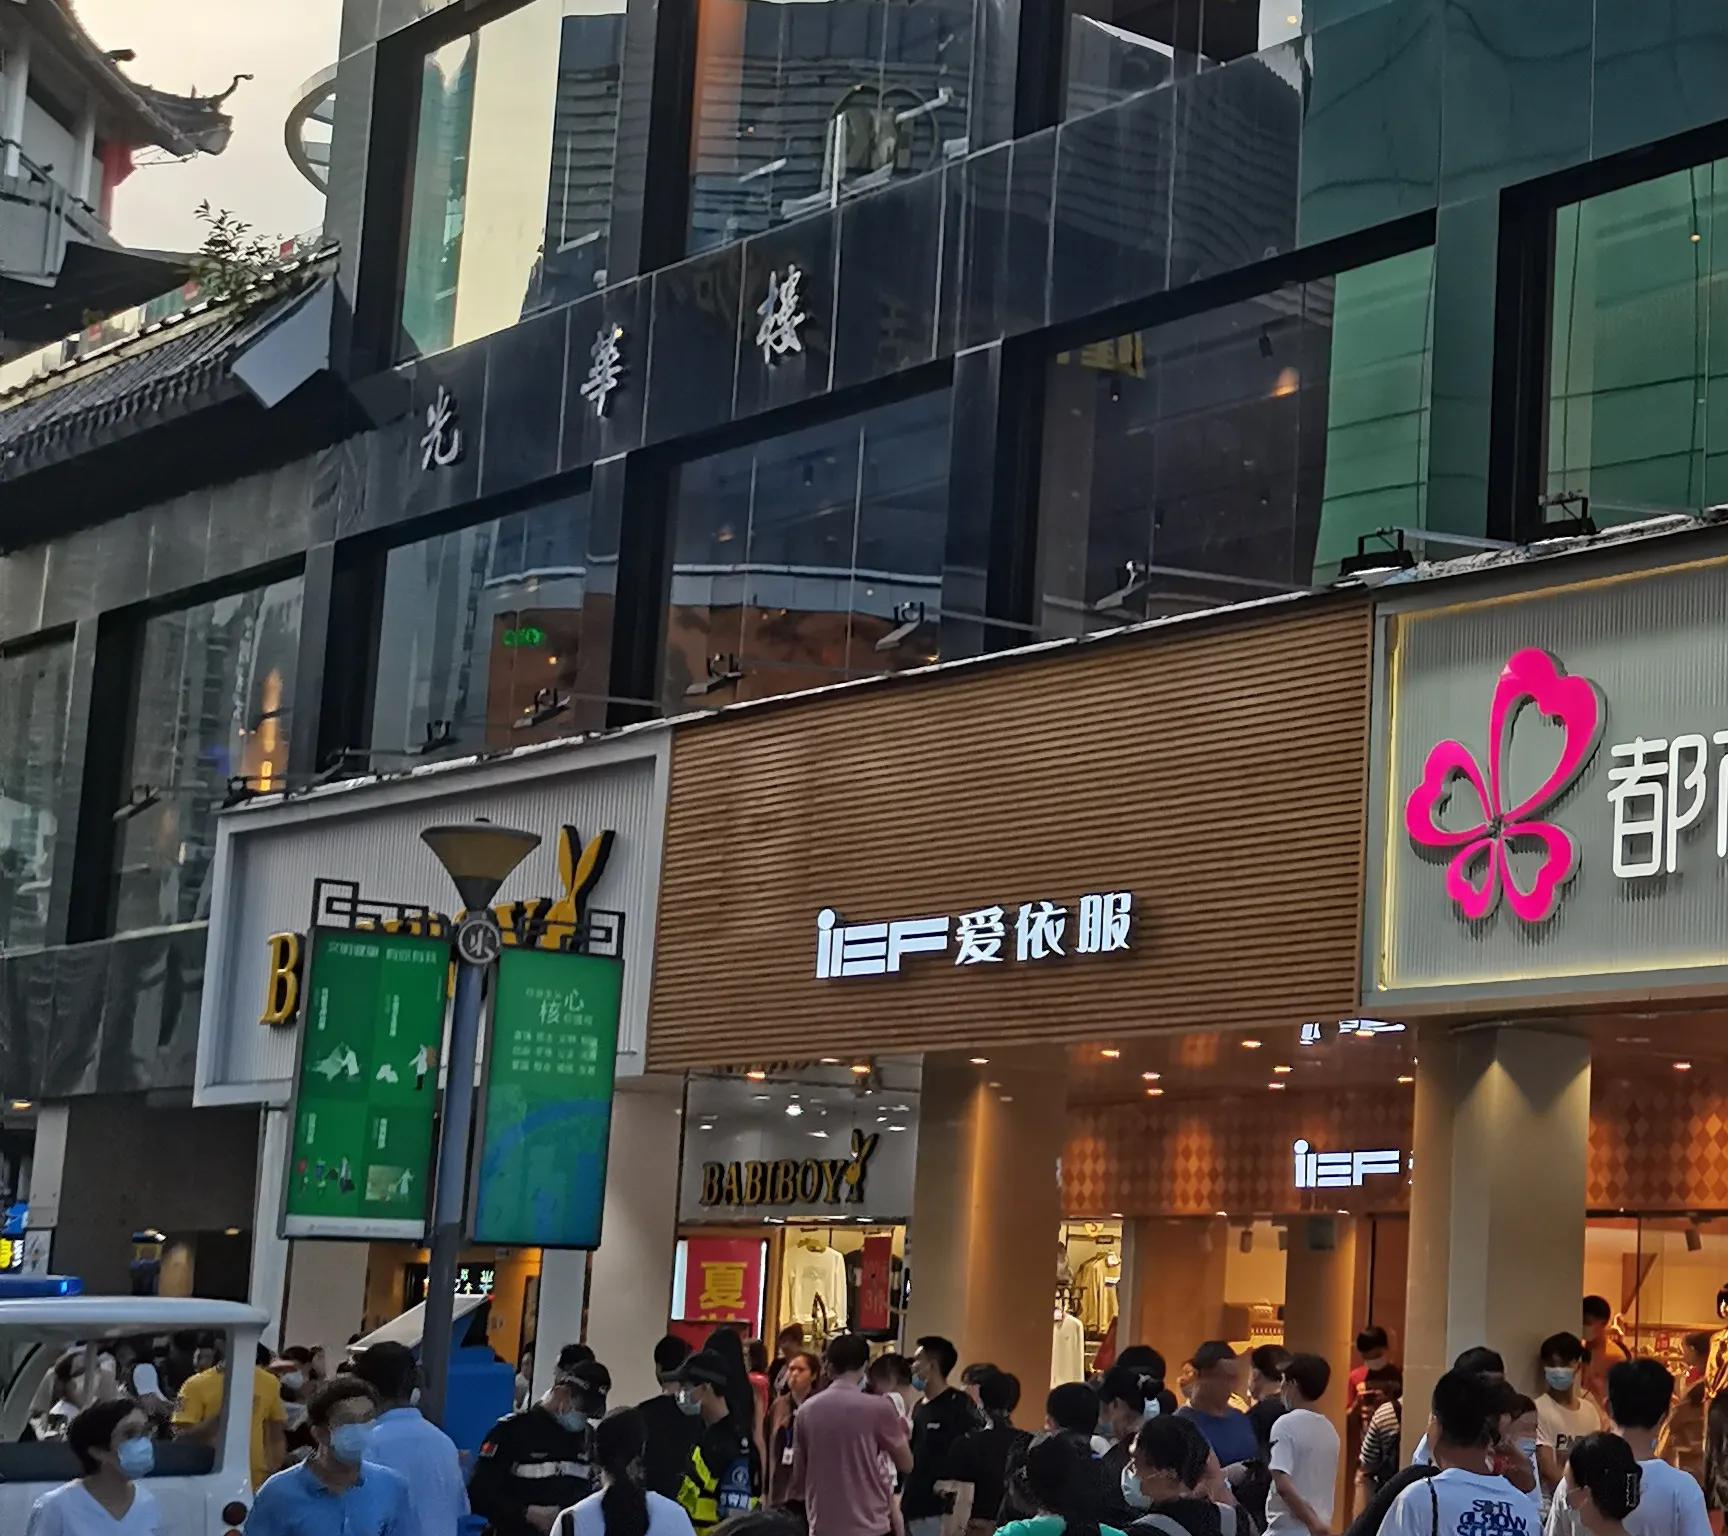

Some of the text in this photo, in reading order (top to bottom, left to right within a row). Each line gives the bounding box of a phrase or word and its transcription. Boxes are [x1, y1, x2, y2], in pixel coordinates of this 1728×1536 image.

[955, 891, 1133, 966] 爱依服
[699, 1261, 748, 1321] 夏
